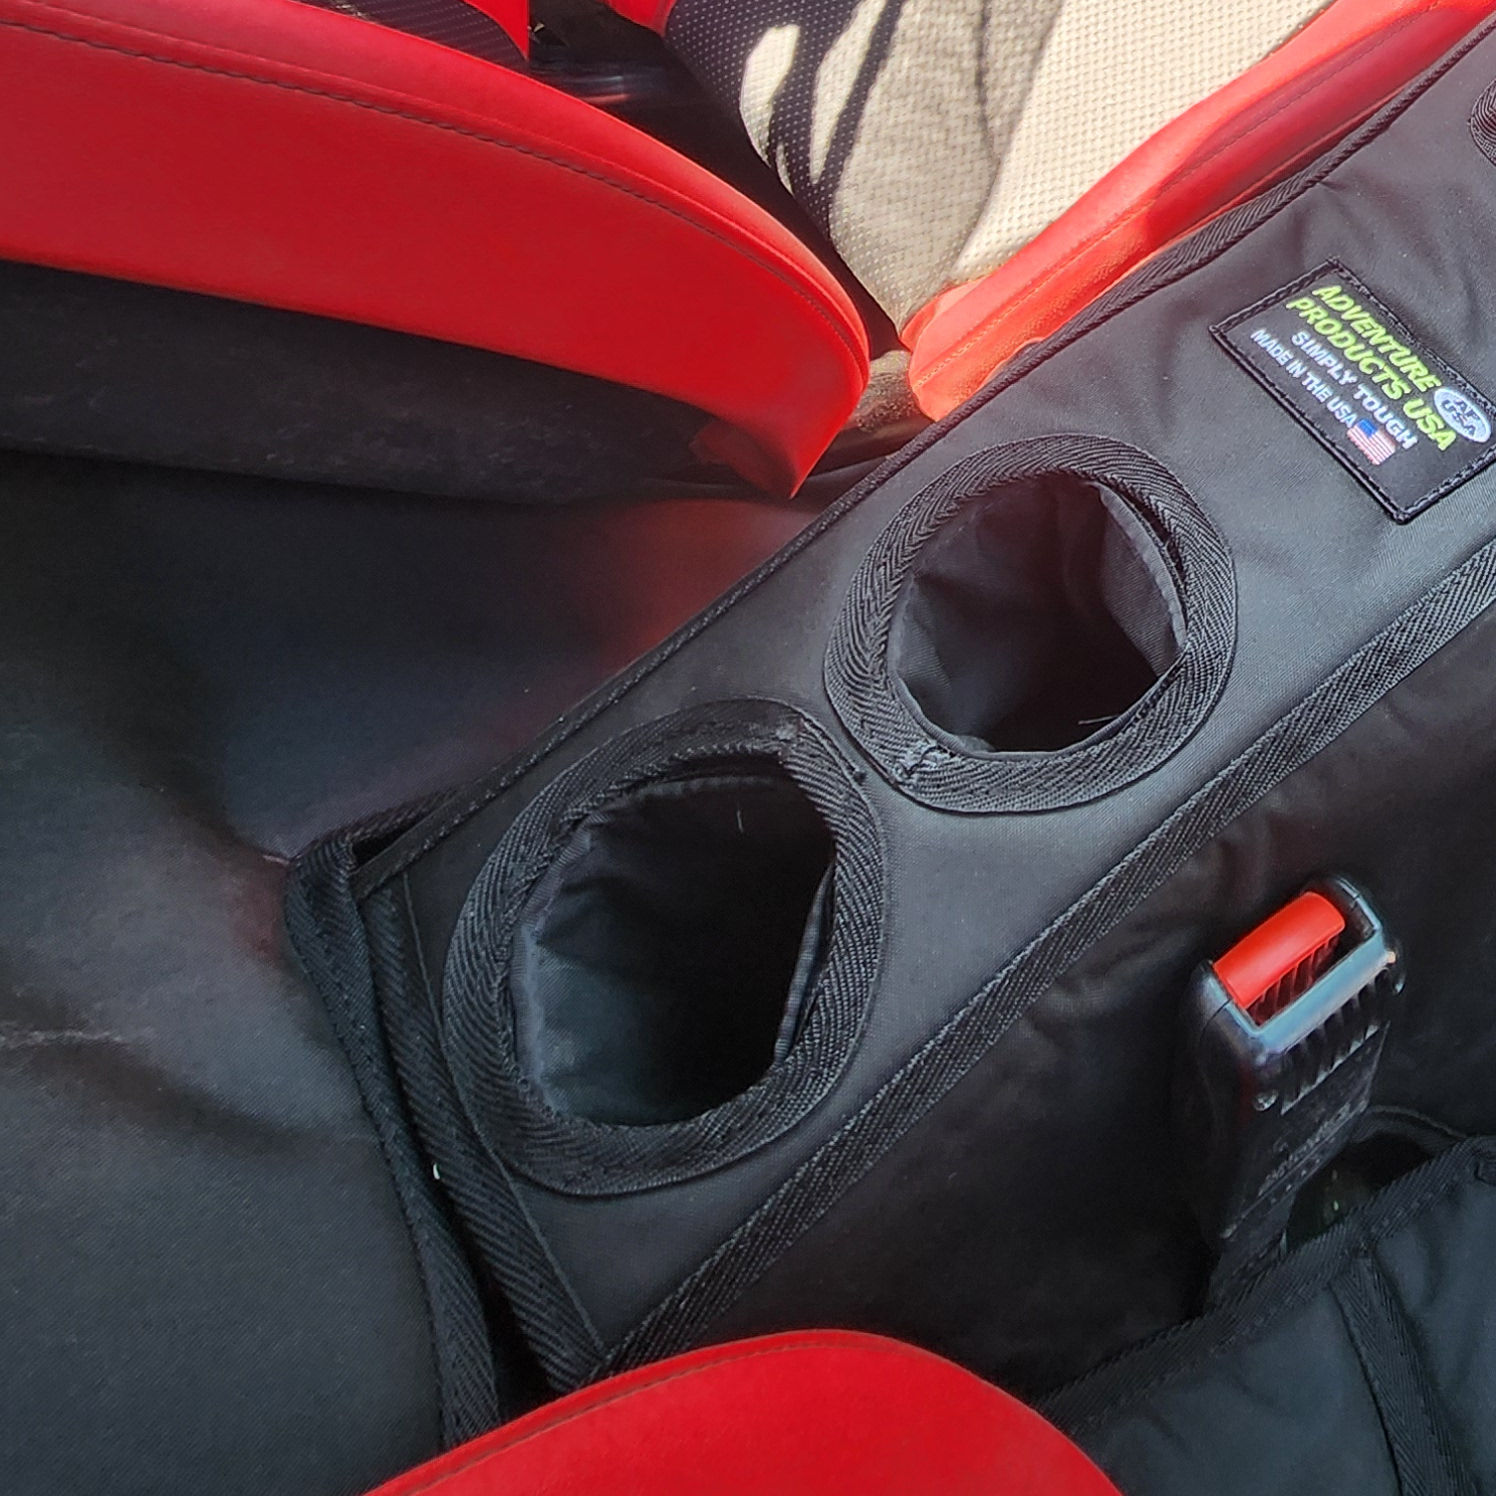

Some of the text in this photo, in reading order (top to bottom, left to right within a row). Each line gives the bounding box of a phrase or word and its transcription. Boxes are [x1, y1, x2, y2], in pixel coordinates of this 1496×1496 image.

[1250, 328, 1359, 428] MADE IN THE USA
[1286, 298, 1458, 451] PRODUCTS USA
[1291, 331, 1418, 449] SIMPLY TOUGH
[1311, 285, 1442, 392] ADVENTURE
